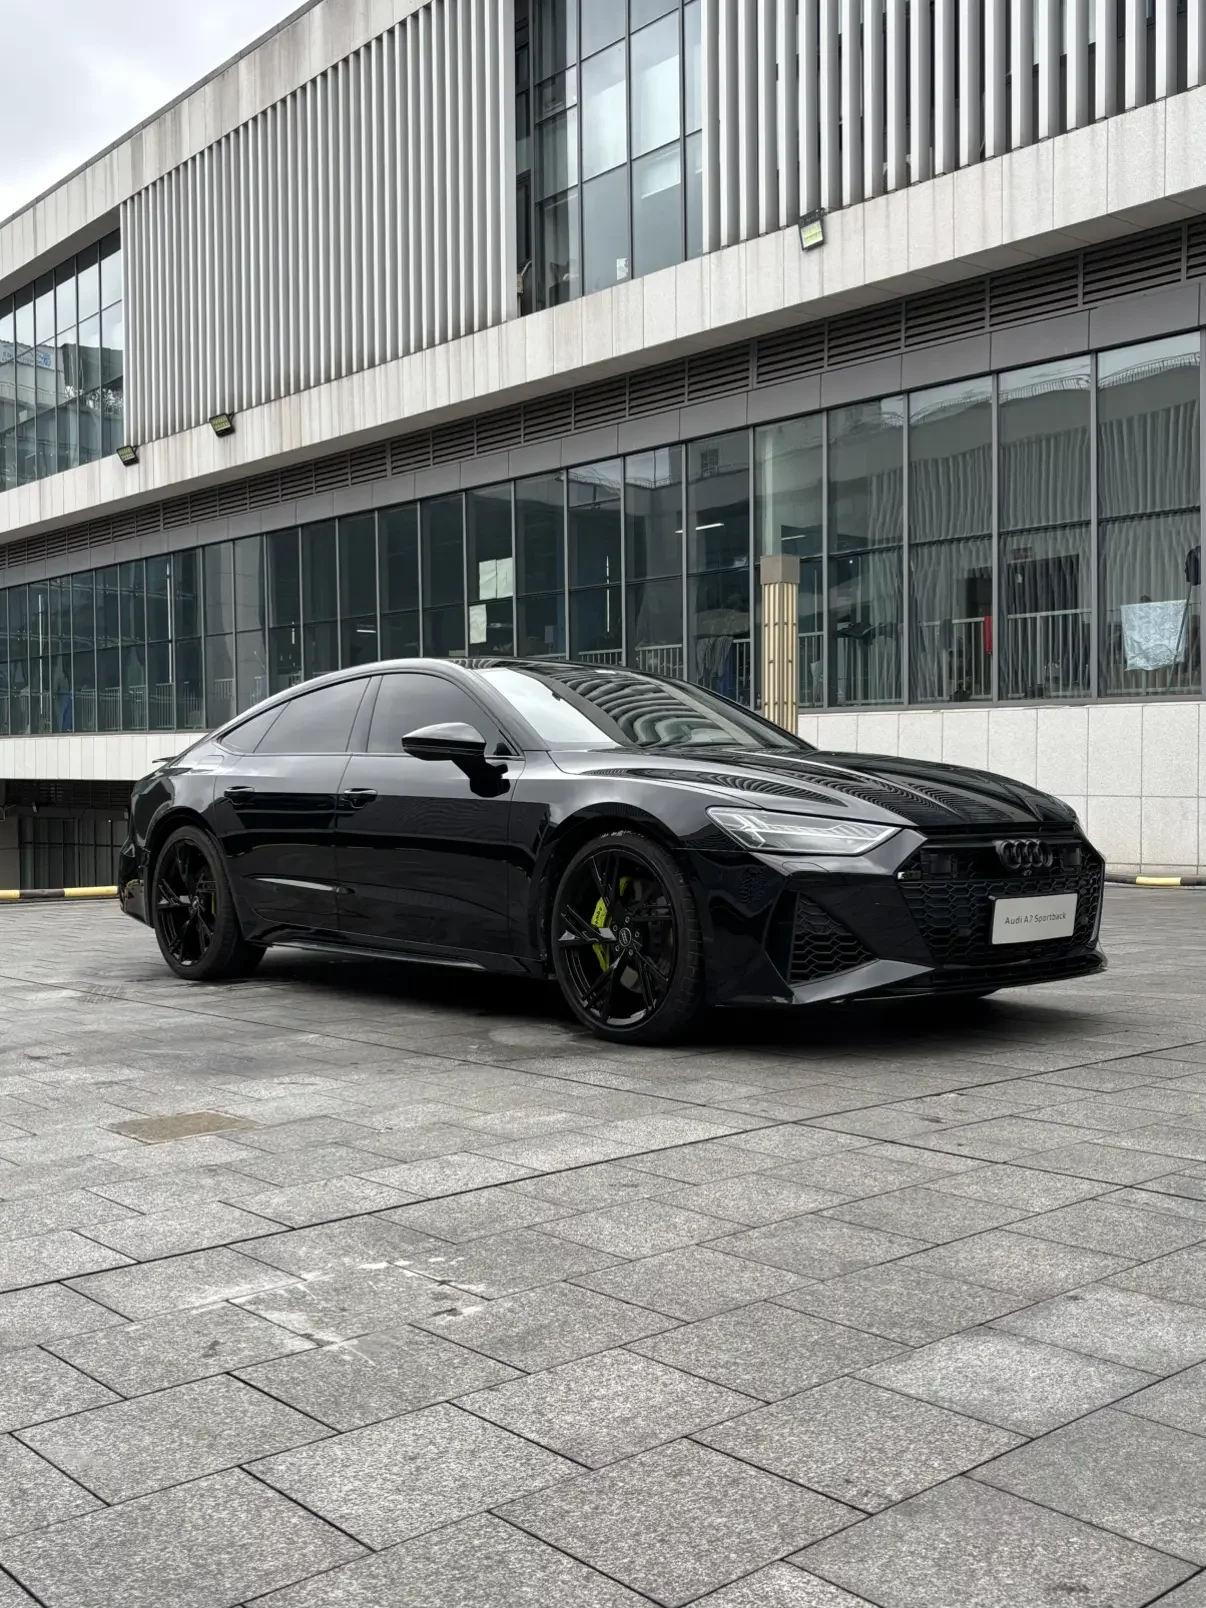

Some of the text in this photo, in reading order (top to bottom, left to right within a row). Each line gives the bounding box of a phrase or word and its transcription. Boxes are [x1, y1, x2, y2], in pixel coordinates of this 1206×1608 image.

[1004, 911, 1066, 924] Audi A7 Sportback
